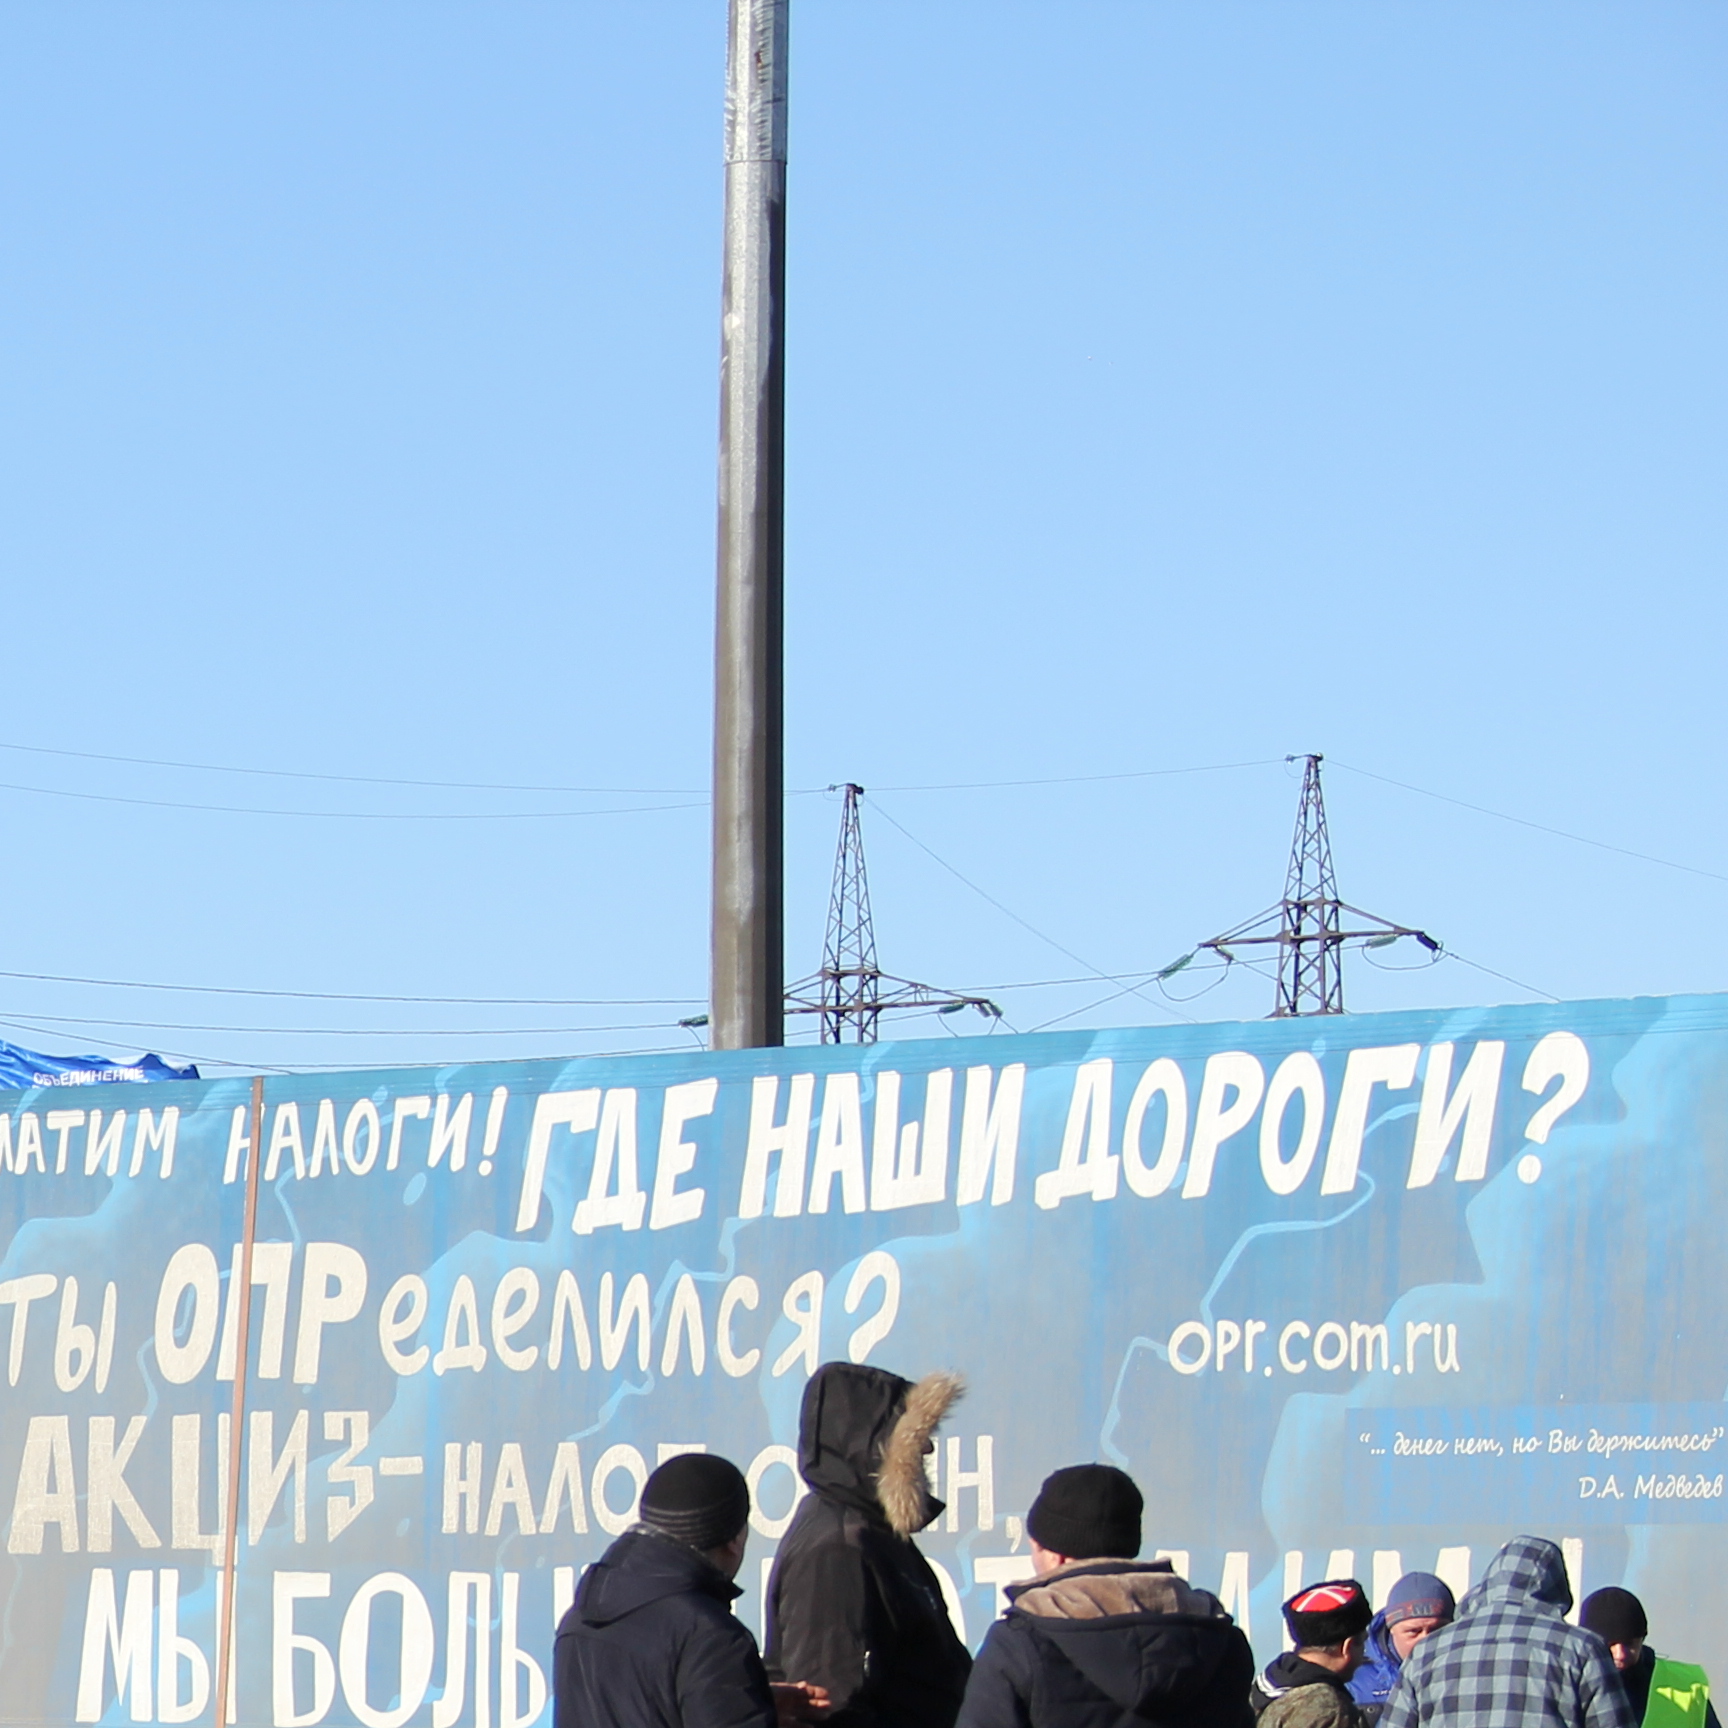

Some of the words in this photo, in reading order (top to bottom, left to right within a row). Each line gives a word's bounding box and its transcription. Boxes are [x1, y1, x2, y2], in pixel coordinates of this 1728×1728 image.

[33, 1066, 144, 1087] ОБЪЕДИНЕНИЕ
[223, 1086, 508, 1185] НАЛОГИ!
[515, 1075, 718, 1236] ГДЕ
[737, 1062, 1026, 1219] НАШИ
[1034, 1030, 1590, 1211] ДОРОГИ?
[1393, 1432, 1449, 1456] денег
[1453, 1437, 1504, 1457] нет,
[1511, 1436, 1542, 1454] но
[1548, 1429, 1583, 1454] Вы
[441, 1438, 706, 1536] НАЛО
[1634, 1474, 1724, 1499] Медведев
[75, 1567, 236, 1726] МЫ
